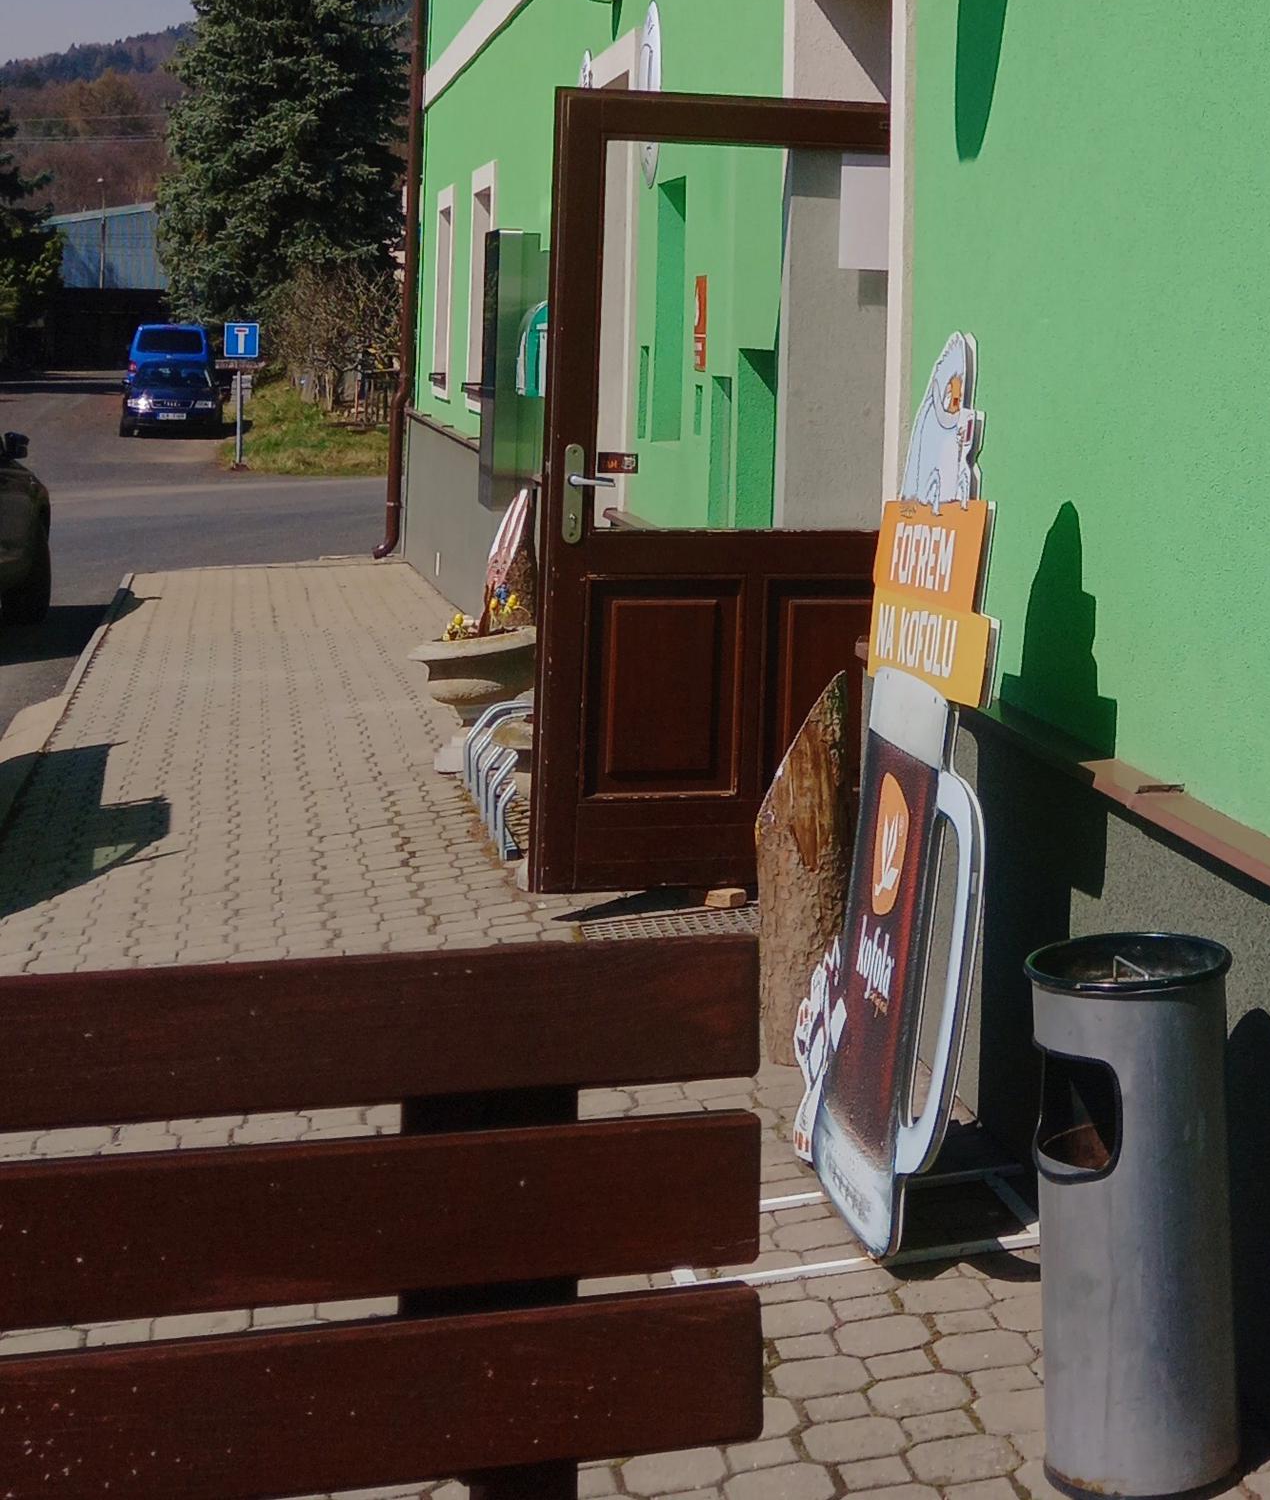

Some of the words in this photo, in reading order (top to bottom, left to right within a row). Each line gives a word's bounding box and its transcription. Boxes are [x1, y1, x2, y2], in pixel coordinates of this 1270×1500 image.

[890, 521, 956, 593] FOFREM
[875, 602, 896, 661] NA
[897, 606, 958, 679] KOFOLU
[856, 914, 895, 1000] kofola
